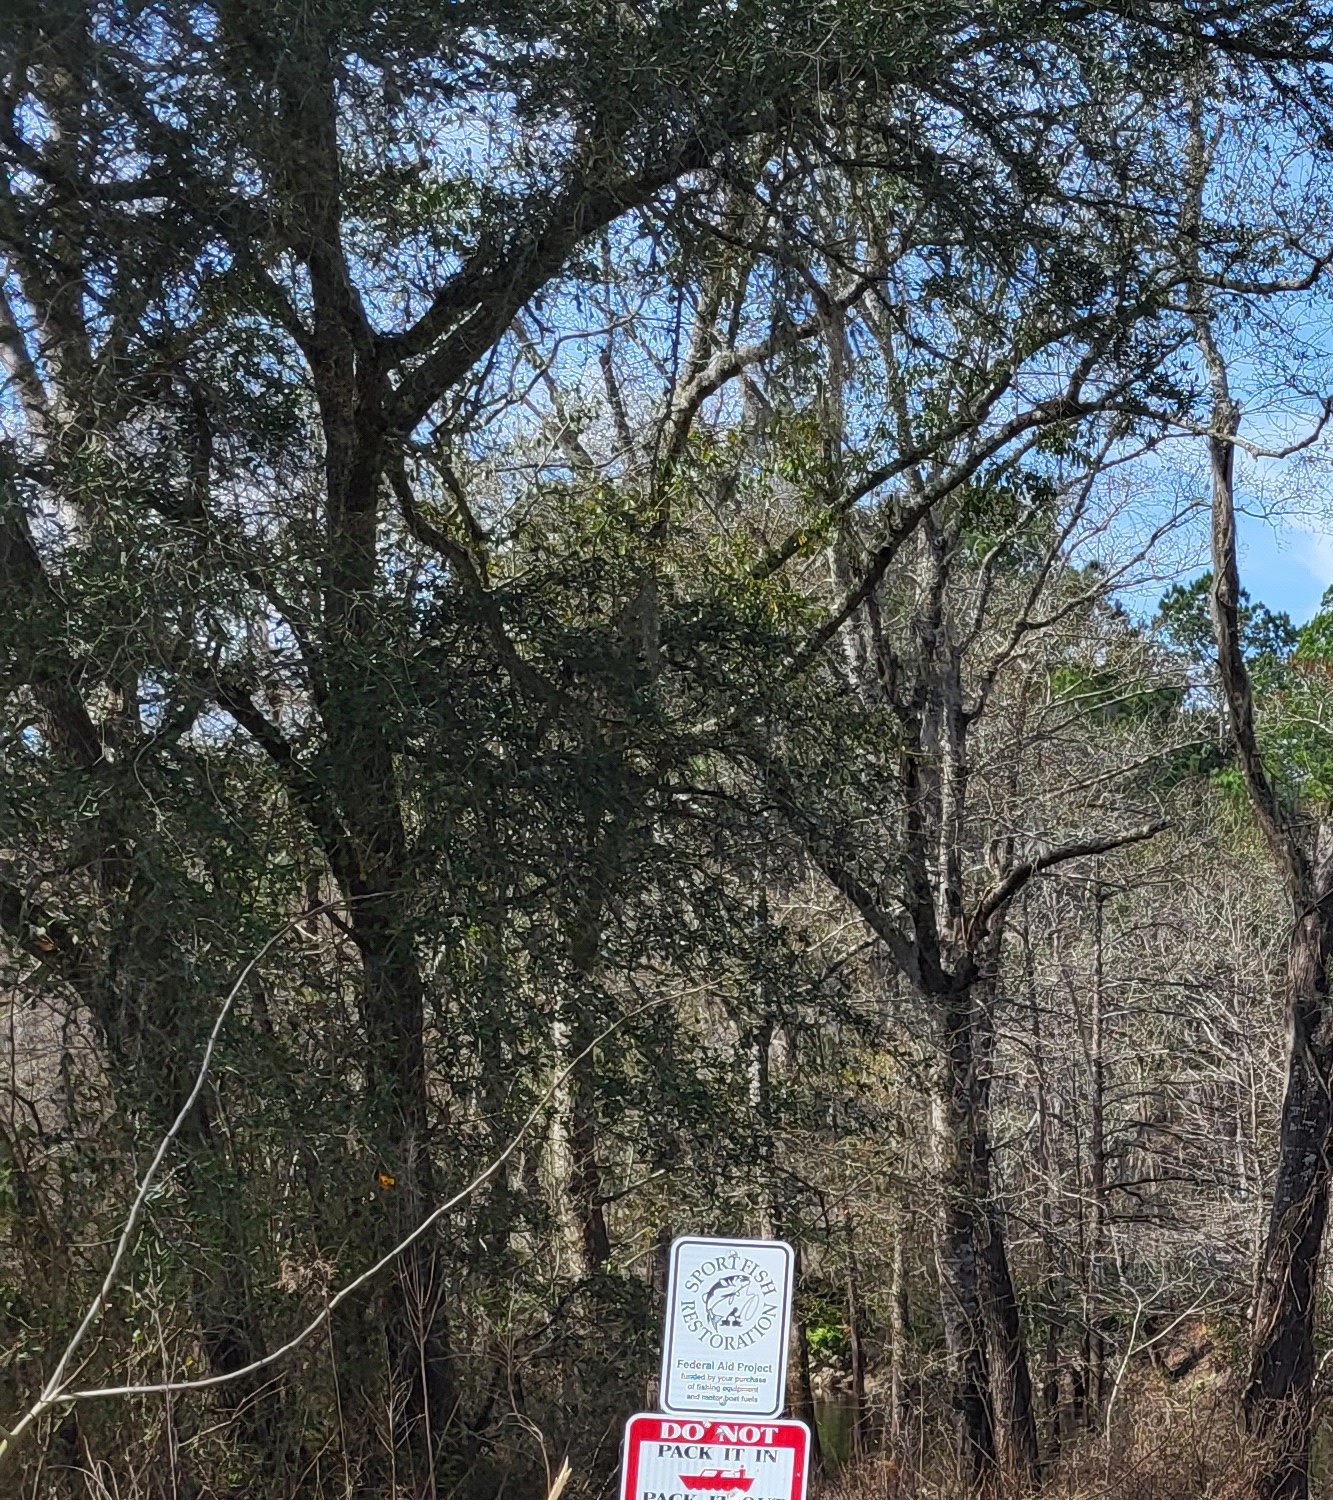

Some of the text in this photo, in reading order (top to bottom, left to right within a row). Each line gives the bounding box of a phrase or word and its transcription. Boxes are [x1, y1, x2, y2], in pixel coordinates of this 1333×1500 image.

[681, 1300, 778, 1350] RESTORATION
[677, 1359, 773, 1374] Federal Aid Project
[707, 1374, 716, 1382] by
[734, 1376, 766, 1384] purchase
[660, 1421, 779, 1444] DO NOT
[658, 1444, 778, 1463] PACK IT IN
